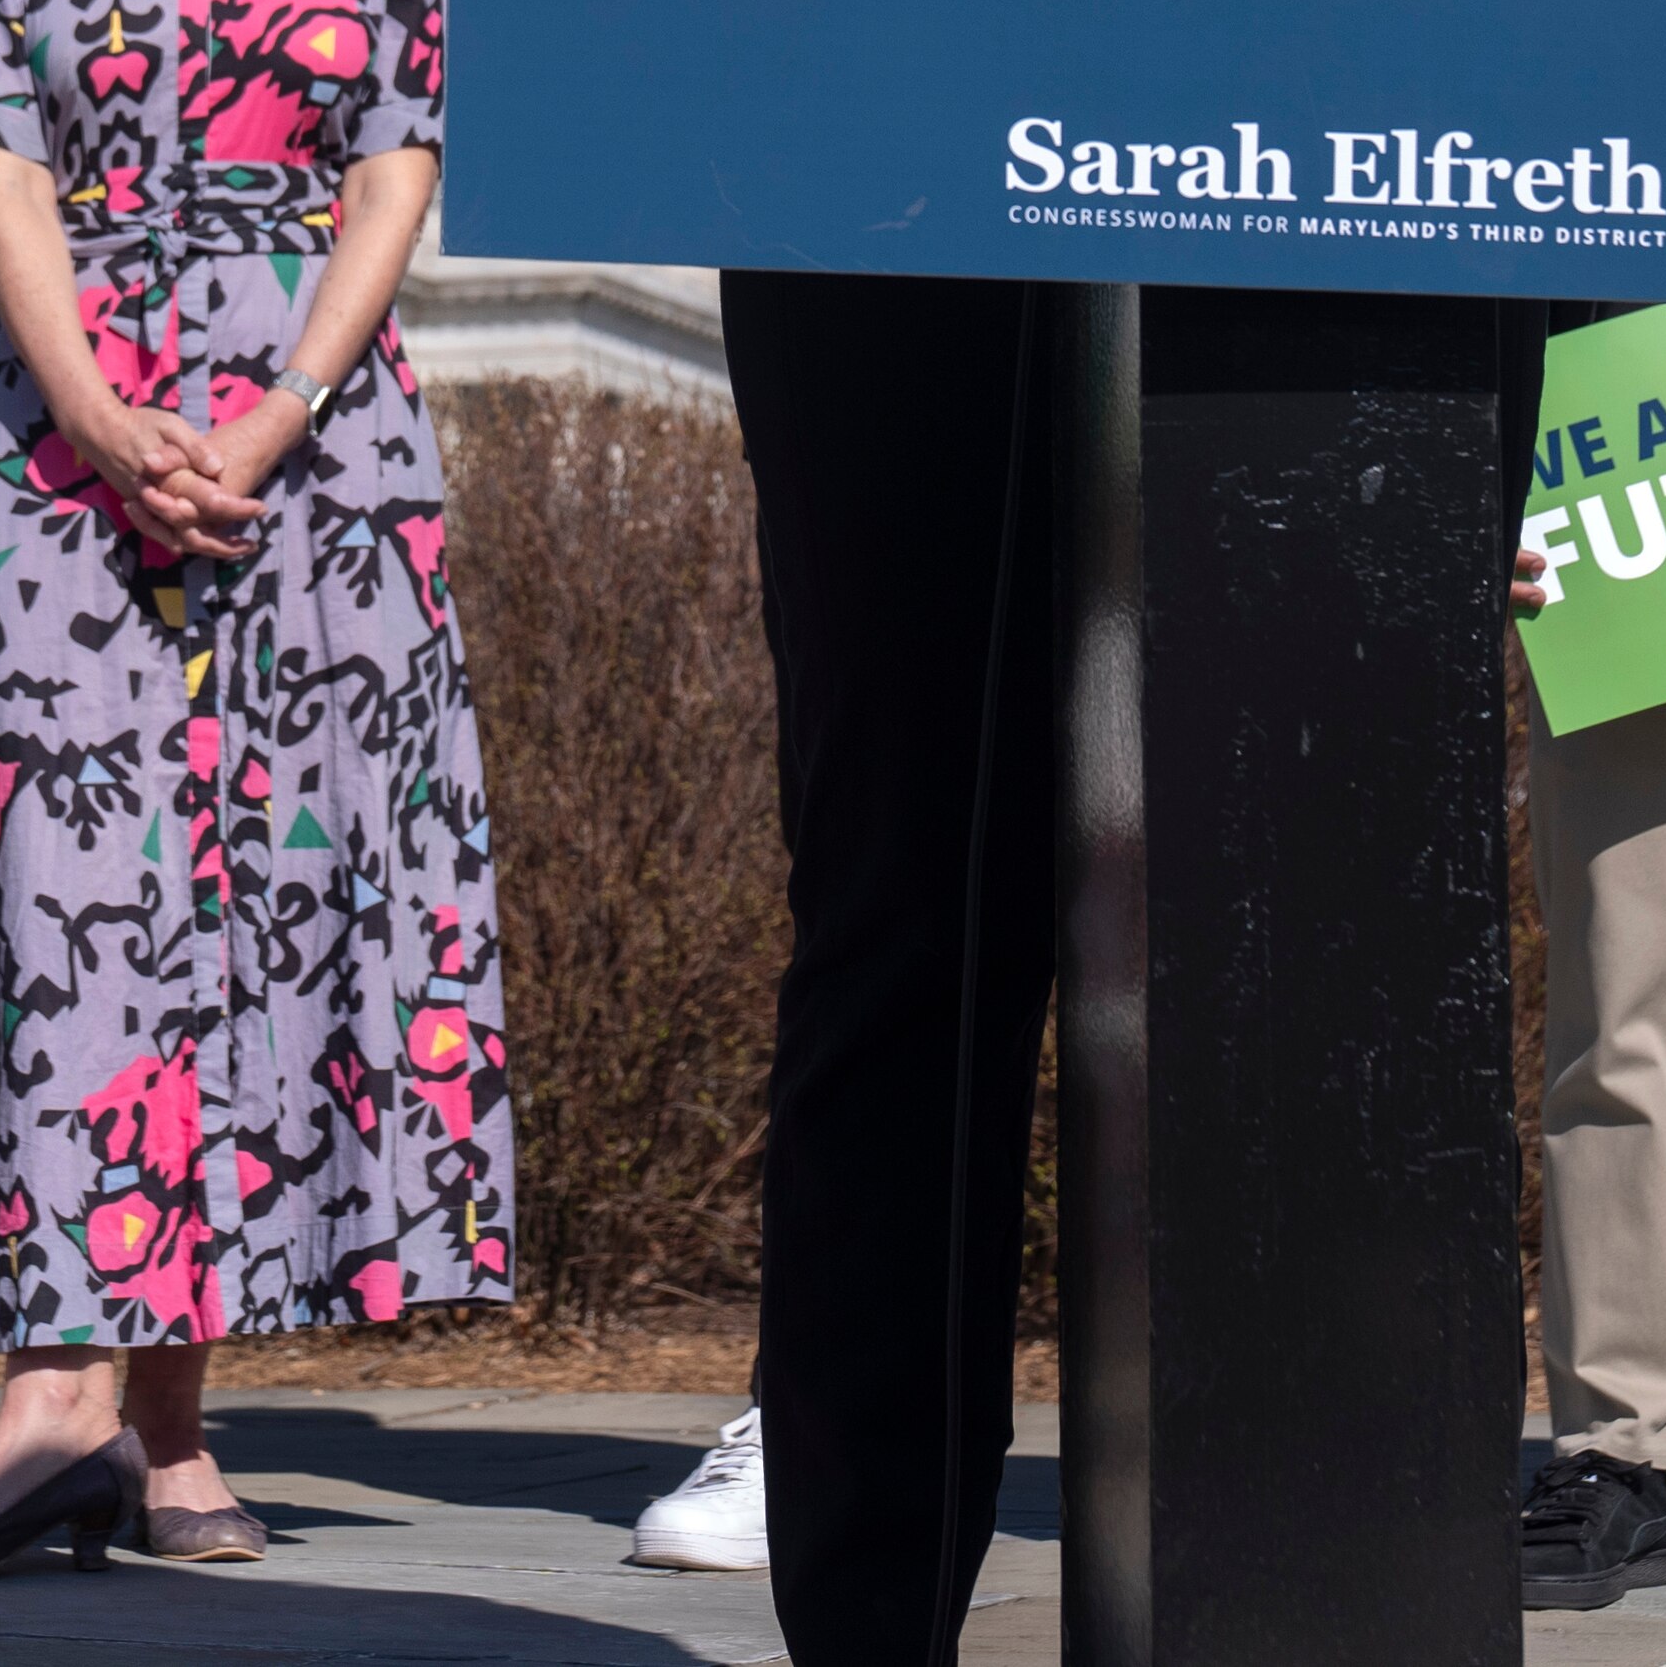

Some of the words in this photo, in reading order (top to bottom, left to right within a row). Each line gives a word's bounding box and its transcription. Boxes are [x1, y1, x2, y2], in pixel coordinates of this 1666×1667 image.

[1005, 117, 1298, 202] Sarah
[1008, 205, 1232, 231] CONGRESSWOMAN
[1243, 214, 1289, 234] FOR
[1299, 216, 1459, 241] MARYLAND'S
[1469, 223, 1545, 243] THIRD
[1555, 226, 1666, 248] DISTRICT
